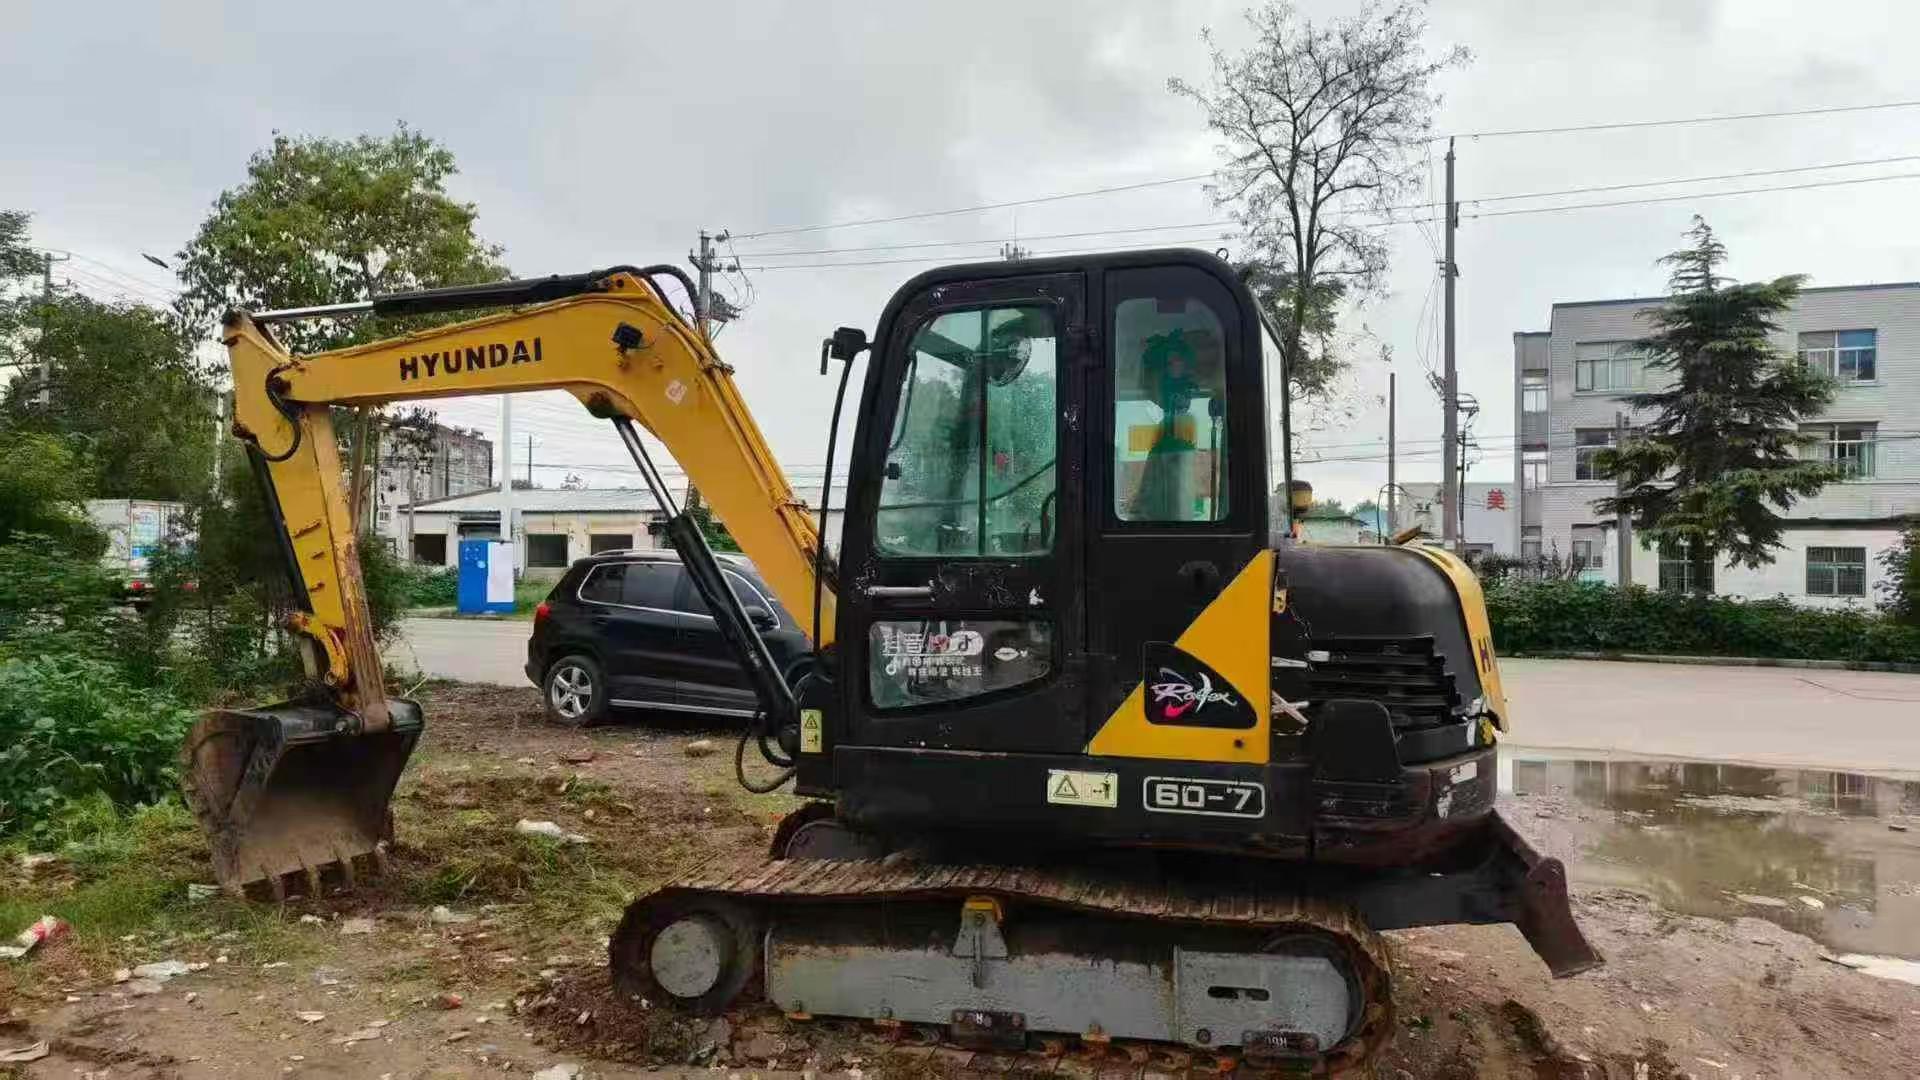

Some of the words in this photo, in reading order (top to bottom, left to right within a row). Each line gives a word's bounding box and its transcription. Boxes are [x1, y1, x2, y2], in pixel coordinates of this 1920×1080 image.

[399, 336, 543, 381] HYUNDAI
[1487, 488, 1506, 510] 美
[1155, 784, 1252, 810] 60-7
